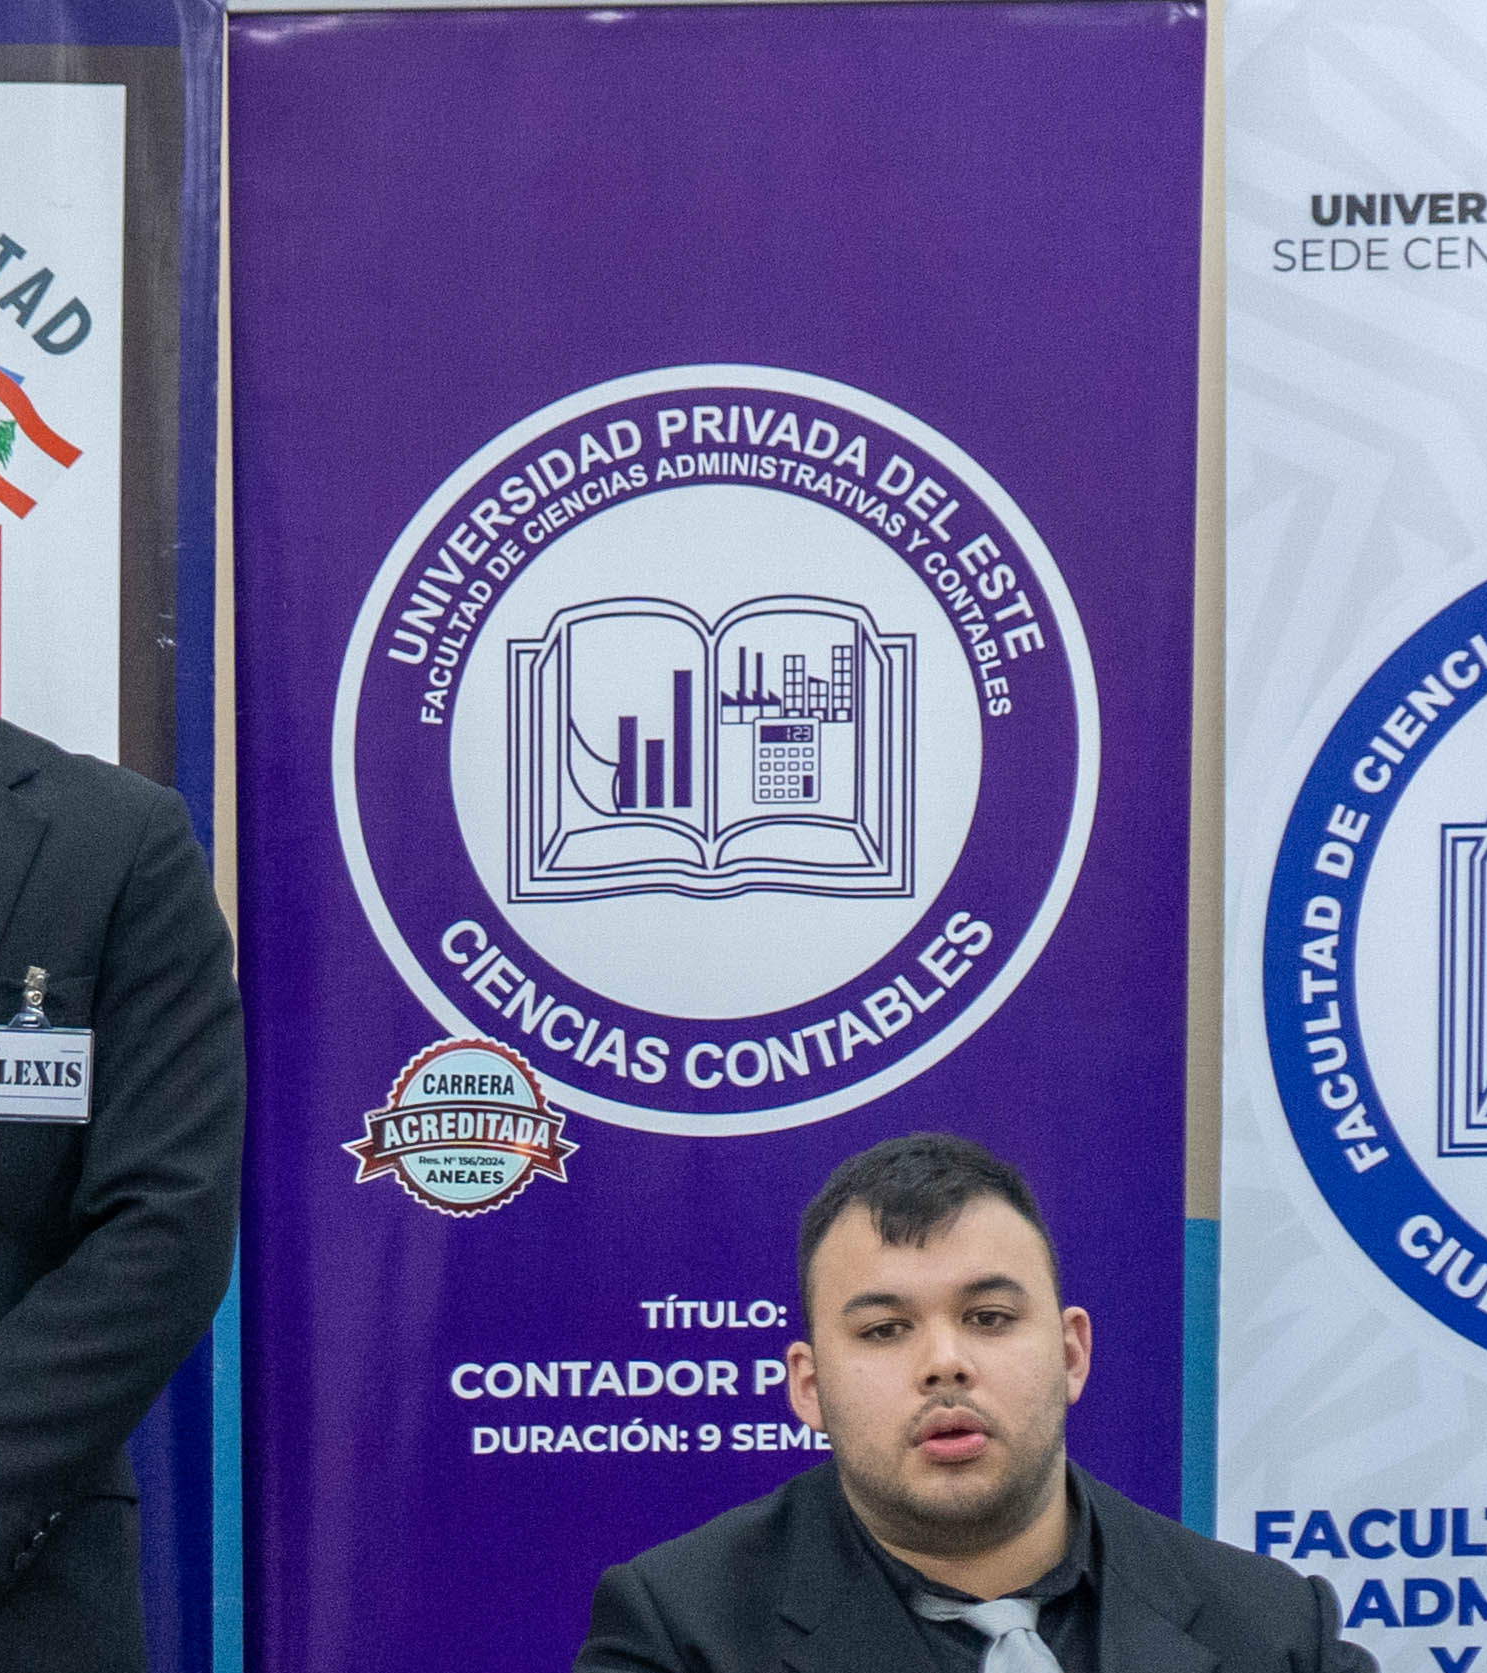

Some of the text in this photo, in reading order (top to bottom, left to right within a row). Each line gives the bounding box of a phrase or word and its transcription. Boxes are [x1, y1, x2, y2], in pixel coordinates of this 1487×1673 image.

[1273, 238, 1388, 272] SEDE
[388, 406, 1044, 664] UNIVERSIDAD PRIVADA DEL ESTE
[421, 452, 1011, 724] FACULTAD DE CIENCIAS ADMINISTRATIVAS Y CONTABLES
[1315, 804, 1369, 878] DE
[442, 912, 992, 1088] CIENCIAS CONTABLES
[1301, 893, 1389, 1173] FACULTAD
[423, 1074, 514, 1095] CARRERA
[384, 1113, 551, 1149] ACREDITADA
[425, 1170, 505, 1184] ANEAES
[641, 1294, 786, 1328] TÍTULO:
[451, 1361, 738, 1399] CONTADOR
[474, 1418, 832, 1454] DURACIÓN: 9 SEME
